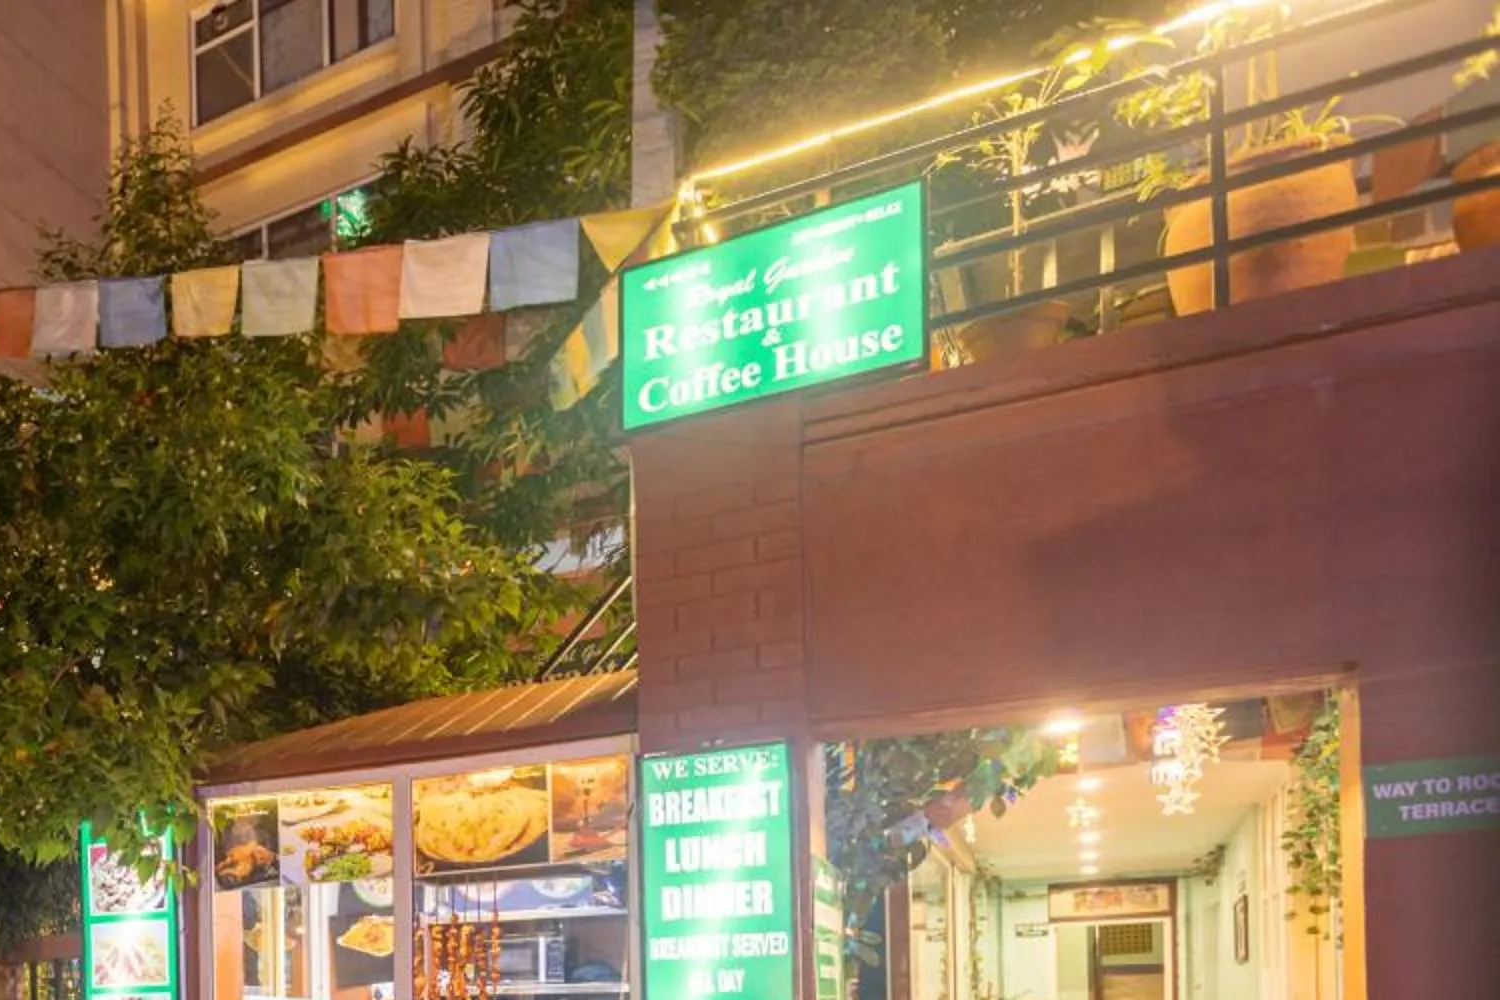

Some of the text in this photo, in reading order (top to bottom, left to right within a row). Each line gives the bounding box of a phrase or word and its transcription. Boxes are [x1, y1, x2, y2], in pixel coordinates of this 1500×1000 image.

[761, 327, 784, 346] &
[638, 323, 903, 413] Coffee House
[651, 751, 779, 781] WE SERVE:
[1373, 782, 1417, 799] WAY
[1422, 778, 1450, 794] TO
[1398, 797, 1500, 821] TERRACE
[665, 830, 767, 872] LUNCH
[650, 931, 788, 961] BREAKST SERVED
[717, 969, 745, 993] DAY
